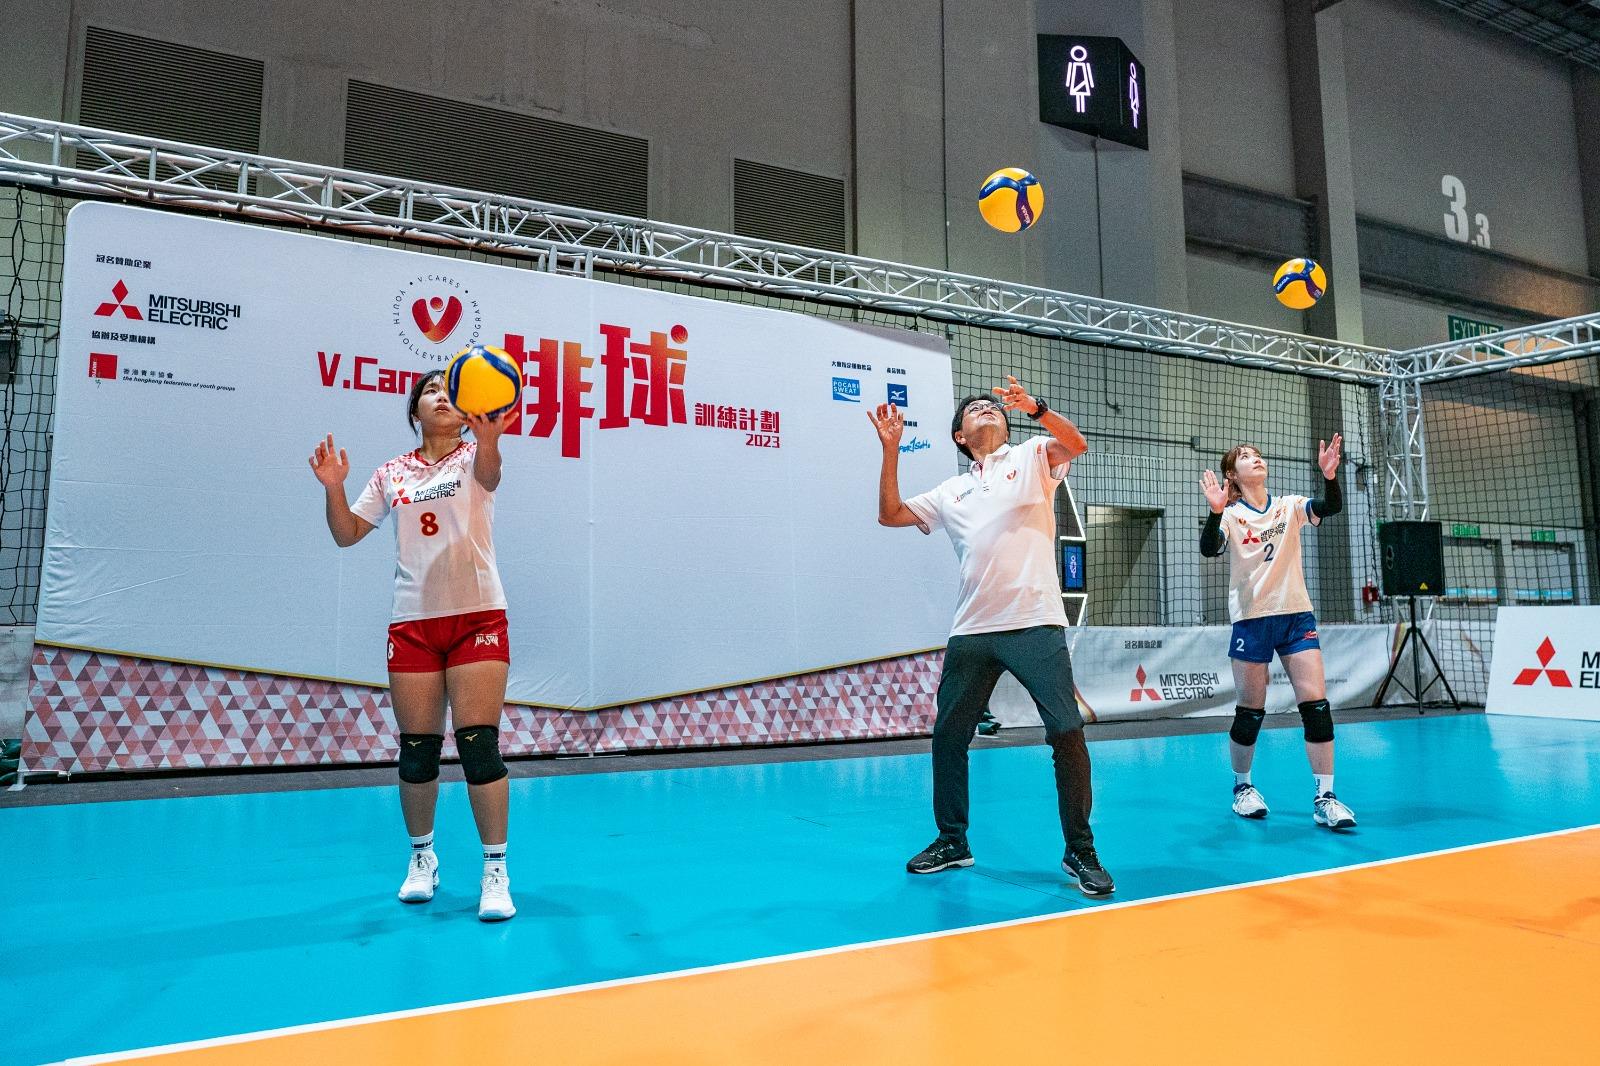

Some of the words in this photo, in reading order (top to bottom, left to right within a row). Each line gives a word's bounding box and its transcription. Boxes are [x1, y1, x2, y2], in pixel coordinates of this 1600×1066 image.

[1441, 175, 1490, 249] 3.3
[149, 294, 241, 318] MITSUBISHI
[393, 289, 406, 325] YOUTH
[148, 308, 228, 330] ELECTRIC
[398, 330, 460, 361] VOLLEYBAL
[833, 381, 859, 389] POCARI
[833, 386, 857, 394] SWEAT
[694, 402, 780, 433] 訓練計劃
[745, 433, 780, 448] 2023
[413, 489, 456, 503] ELECTRIC
[420, 512, 439, 536] 8
[1263, 543, 1274, 562] 2
[1236, 638, 1245, 652] 2
[1159, 673, 1220, 687] MITSUBISHI
[1161, 686, 1215, 700] ELECTRIC
